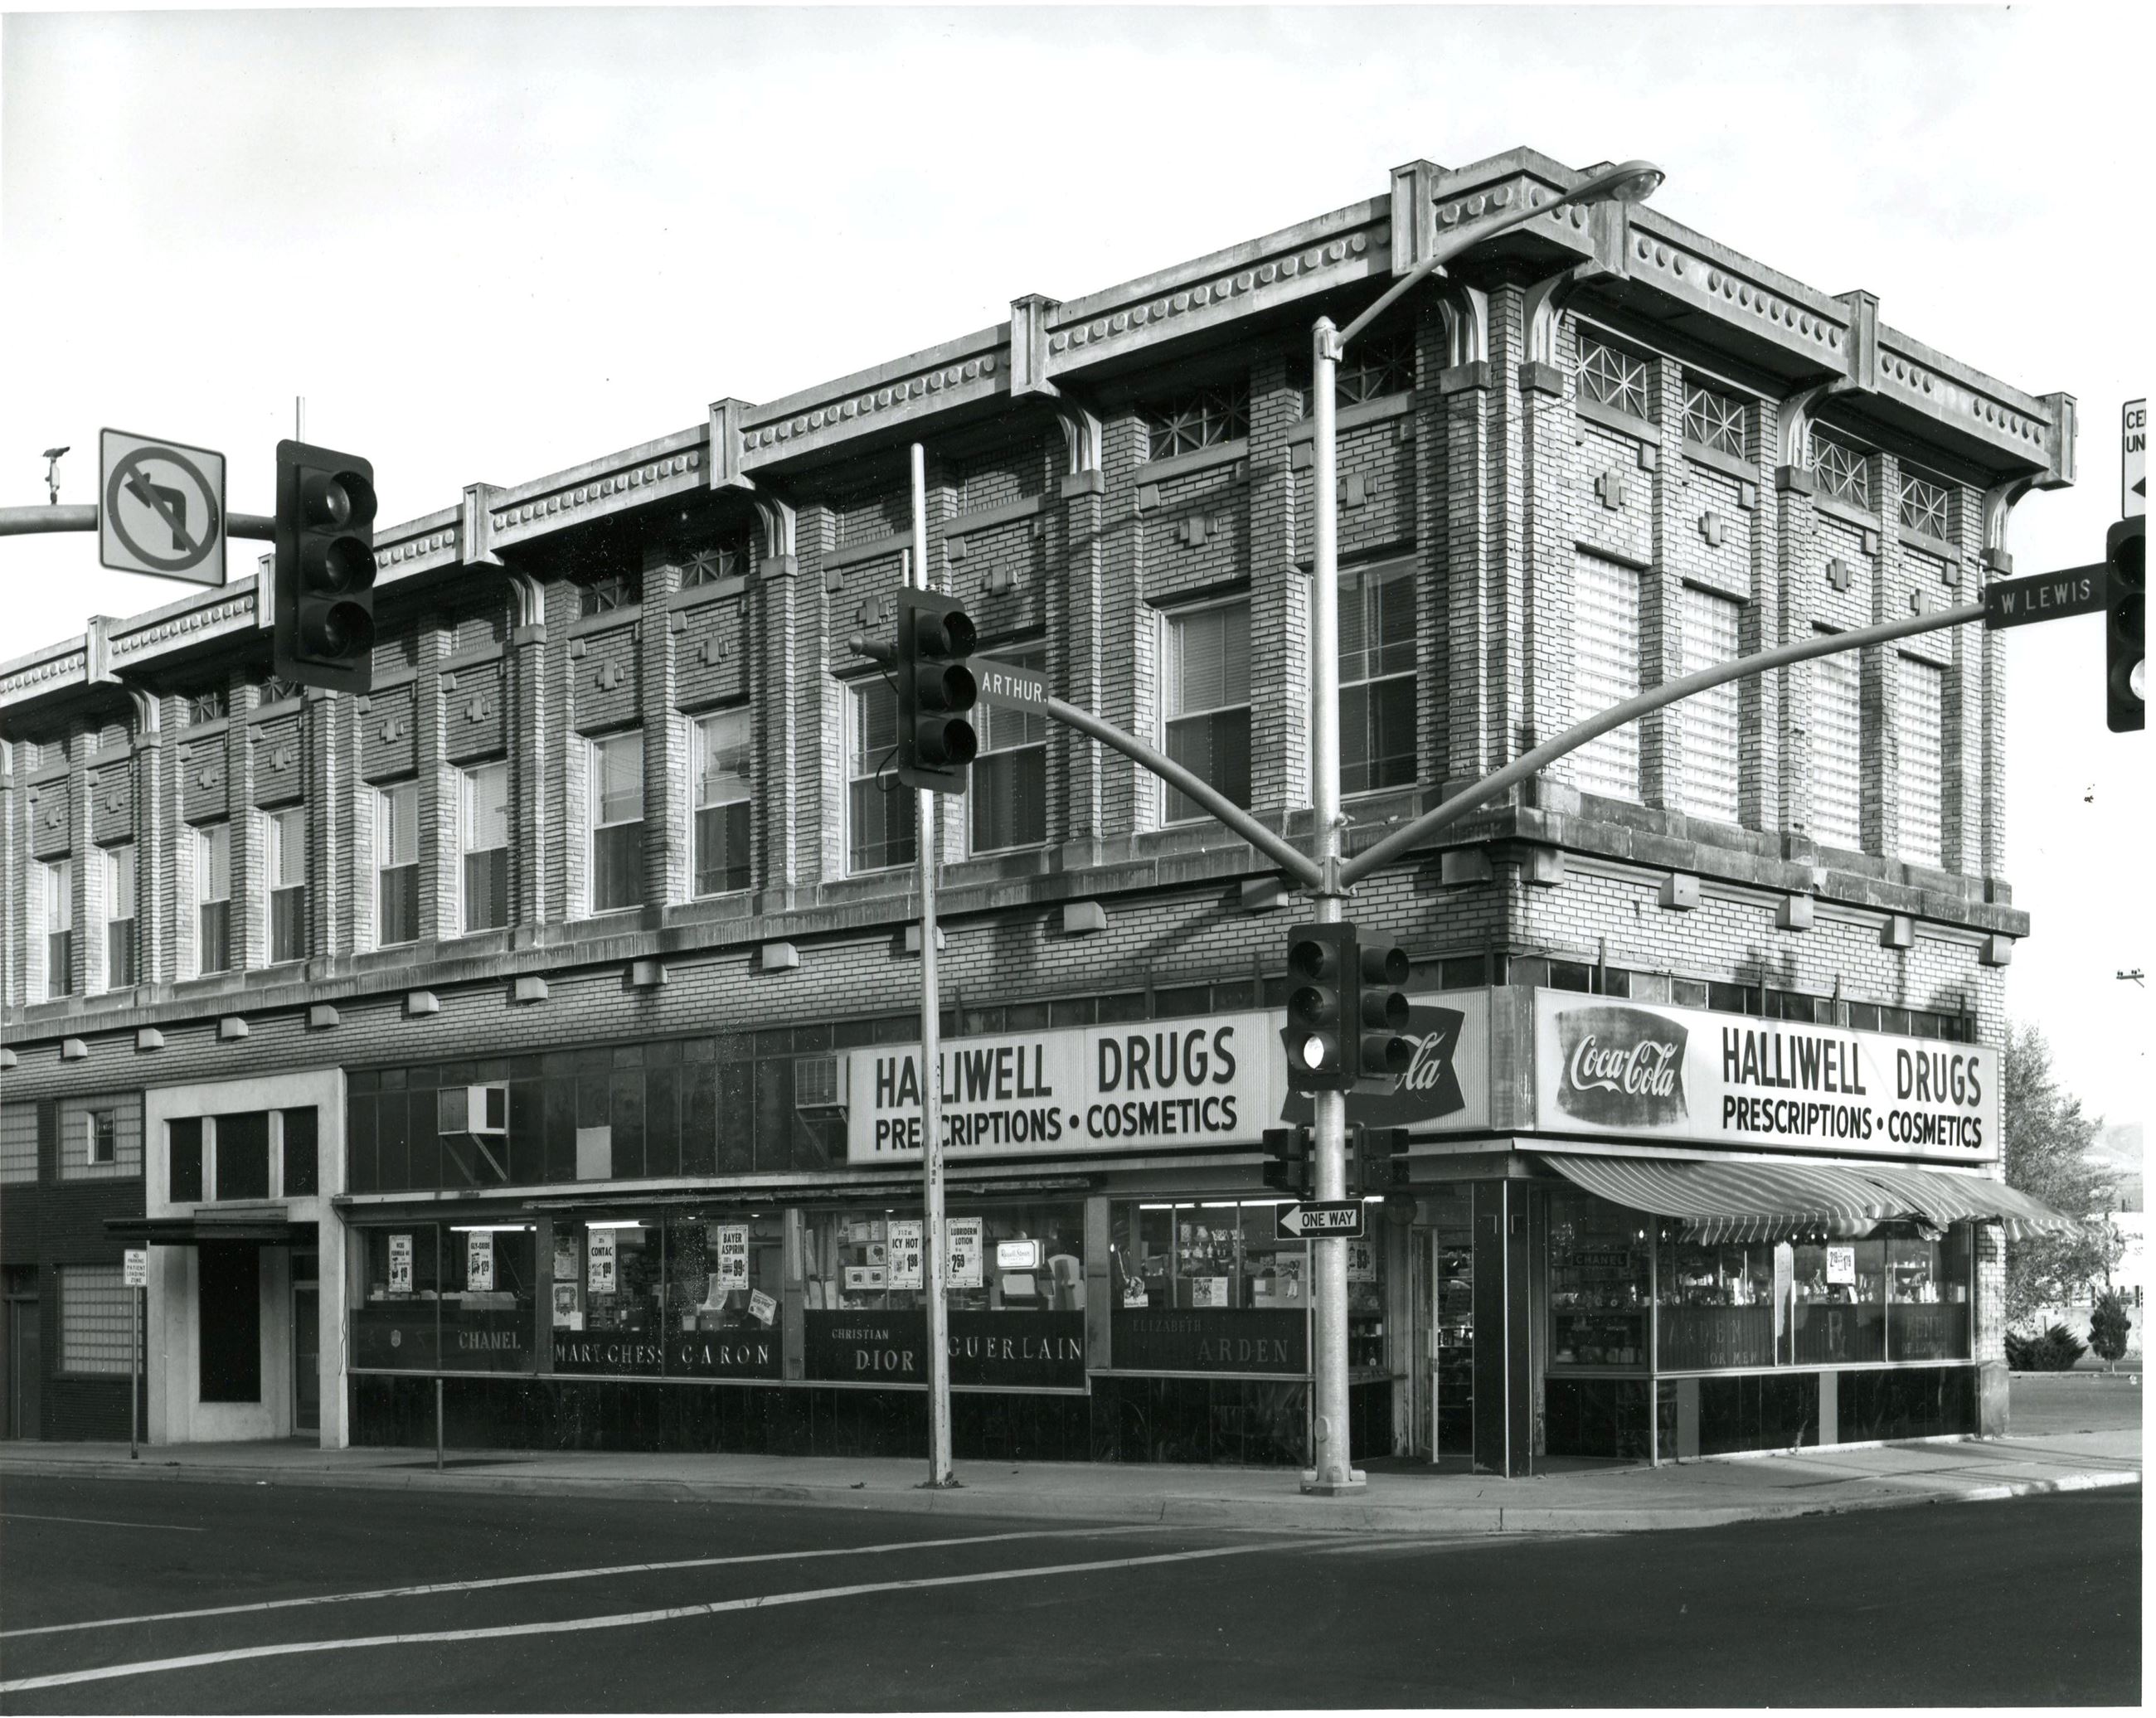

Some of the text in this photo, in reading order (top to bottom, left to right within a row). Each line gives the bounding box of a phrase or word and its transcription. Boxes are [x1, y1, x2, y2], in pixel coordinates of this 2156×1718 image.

[2126, 409, 2146, 430] CE
[2126, 433, 2146, 453] UN
[2001, 579, 2090, 614] W LEWIS
[876, 1044, 1051, 1109] HALIWELL
[1099, 1026, 1236, 1093] DRUGS
[1570, 1034, 1678, 1097] Coca-Cola
[1722, 1026, 1982, 1108] HALLIWELL DRUGS
[876, 1094, 1238, 1151] PRECRIPTIONS COSMETICS
[1722, 1095, 1982, 1148] PRESCRIPTIONS COSMETICS
[1302, 1211, 1353, 1227] ONE WAY
[723, 1233, 742, 1243] BAYER
[950, 1227, 978, 1236] LUBRIDERM
[955, 1237, 973, 1245] LOTION
[591, 1247, 612, 1257] CONTAC
[721, 1245, 745, 1255] ASPIRIN
[892, 1238, 919, 1249] ICY HOT
[1576, 1255, 1624, 1266] CHANEL
[832, 1328, 889, 1340] CHRISTIAN
[1133, 1319, 1202, 1333] ELIZABETH
[459, 1331, 521, 1350] CHANEL
[948, 1336, 1083, 1360] GUERLAIN
[555, 1343, 600, 1362] MARY
[682, 1344, 770, 1365] CARON
[855, 1349, 915, 1371] DIOR
[1197, 1338, 1289, 1363] ARDEN
